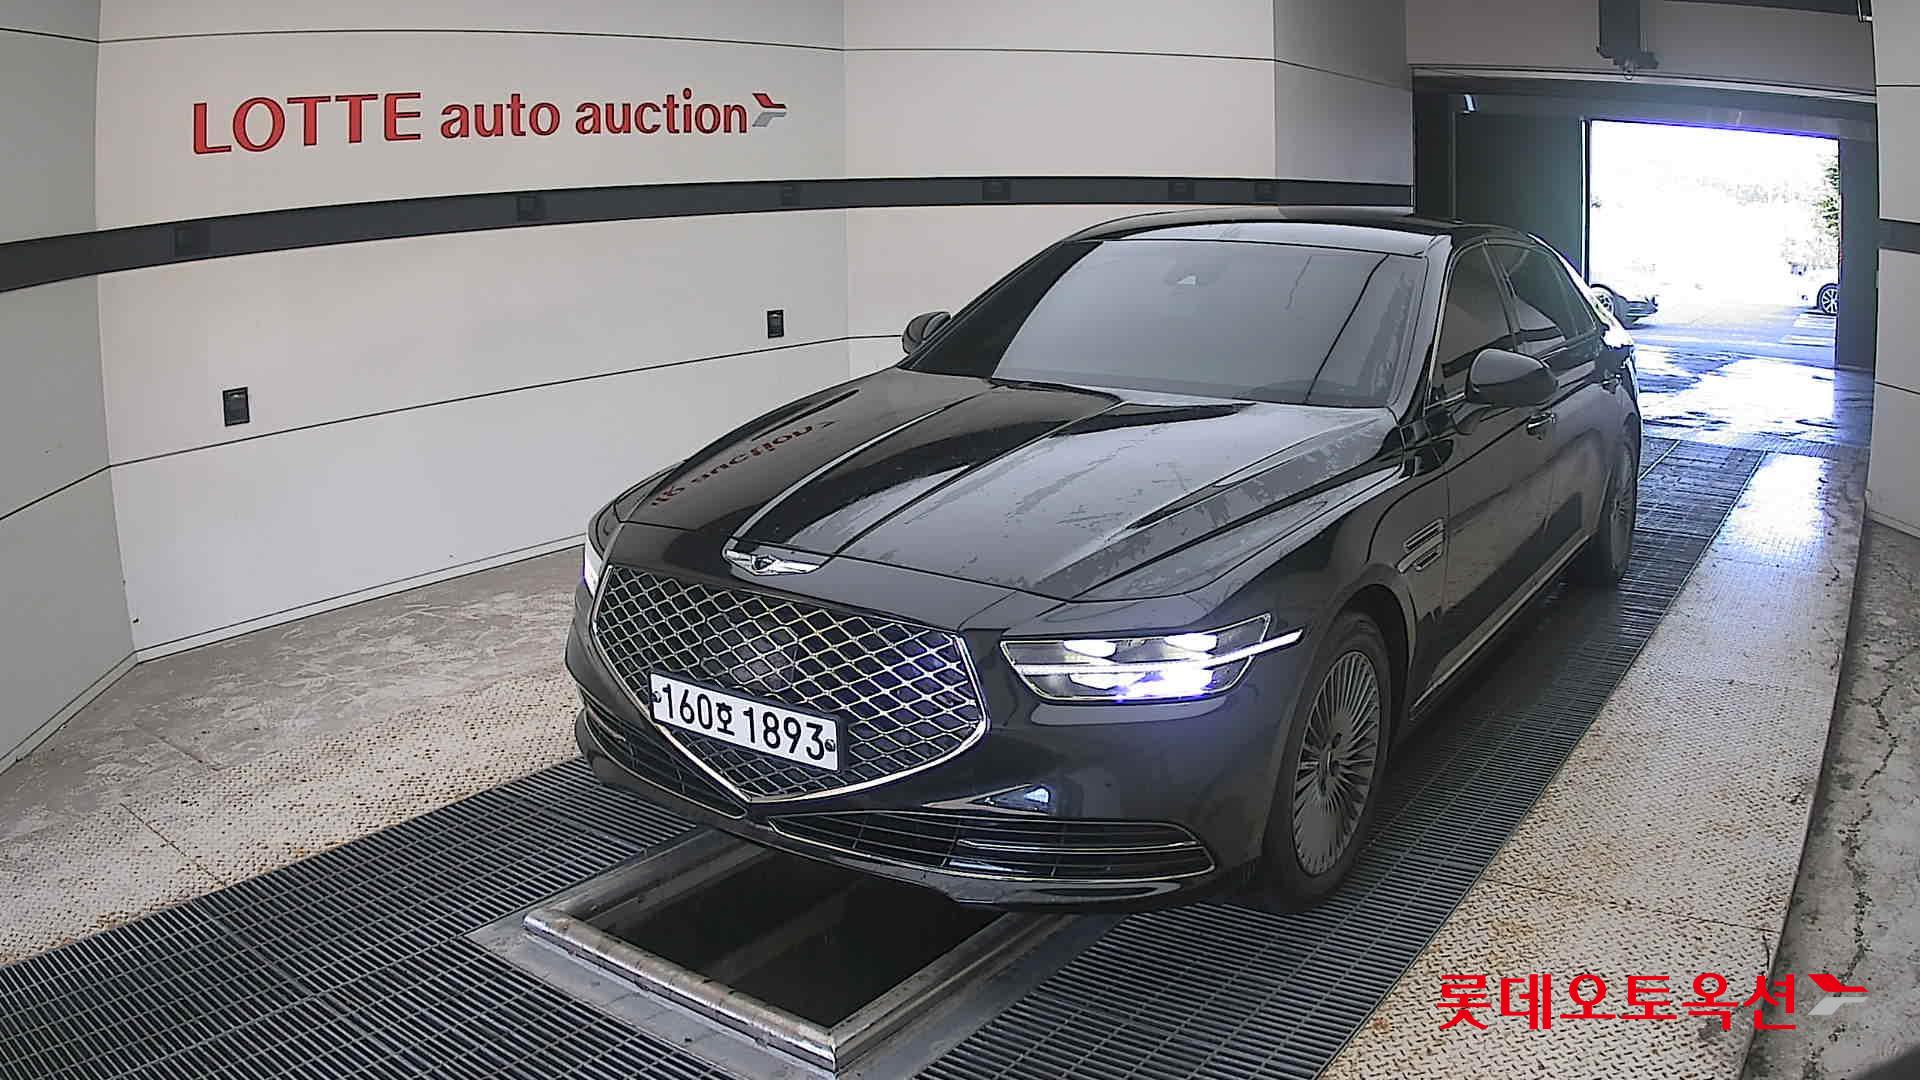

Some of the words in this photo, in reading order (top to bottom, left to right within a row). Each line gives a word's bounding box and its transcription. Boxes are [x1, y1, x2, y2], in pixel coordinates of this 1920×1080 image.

[193, 92, 421, 155] LOTTE
[440, 94, 561, 138] auto
[575, 88, 748, 135] auction
[662, 683, 735, 736] 160호
[743, 706, 825, 761] 1893
